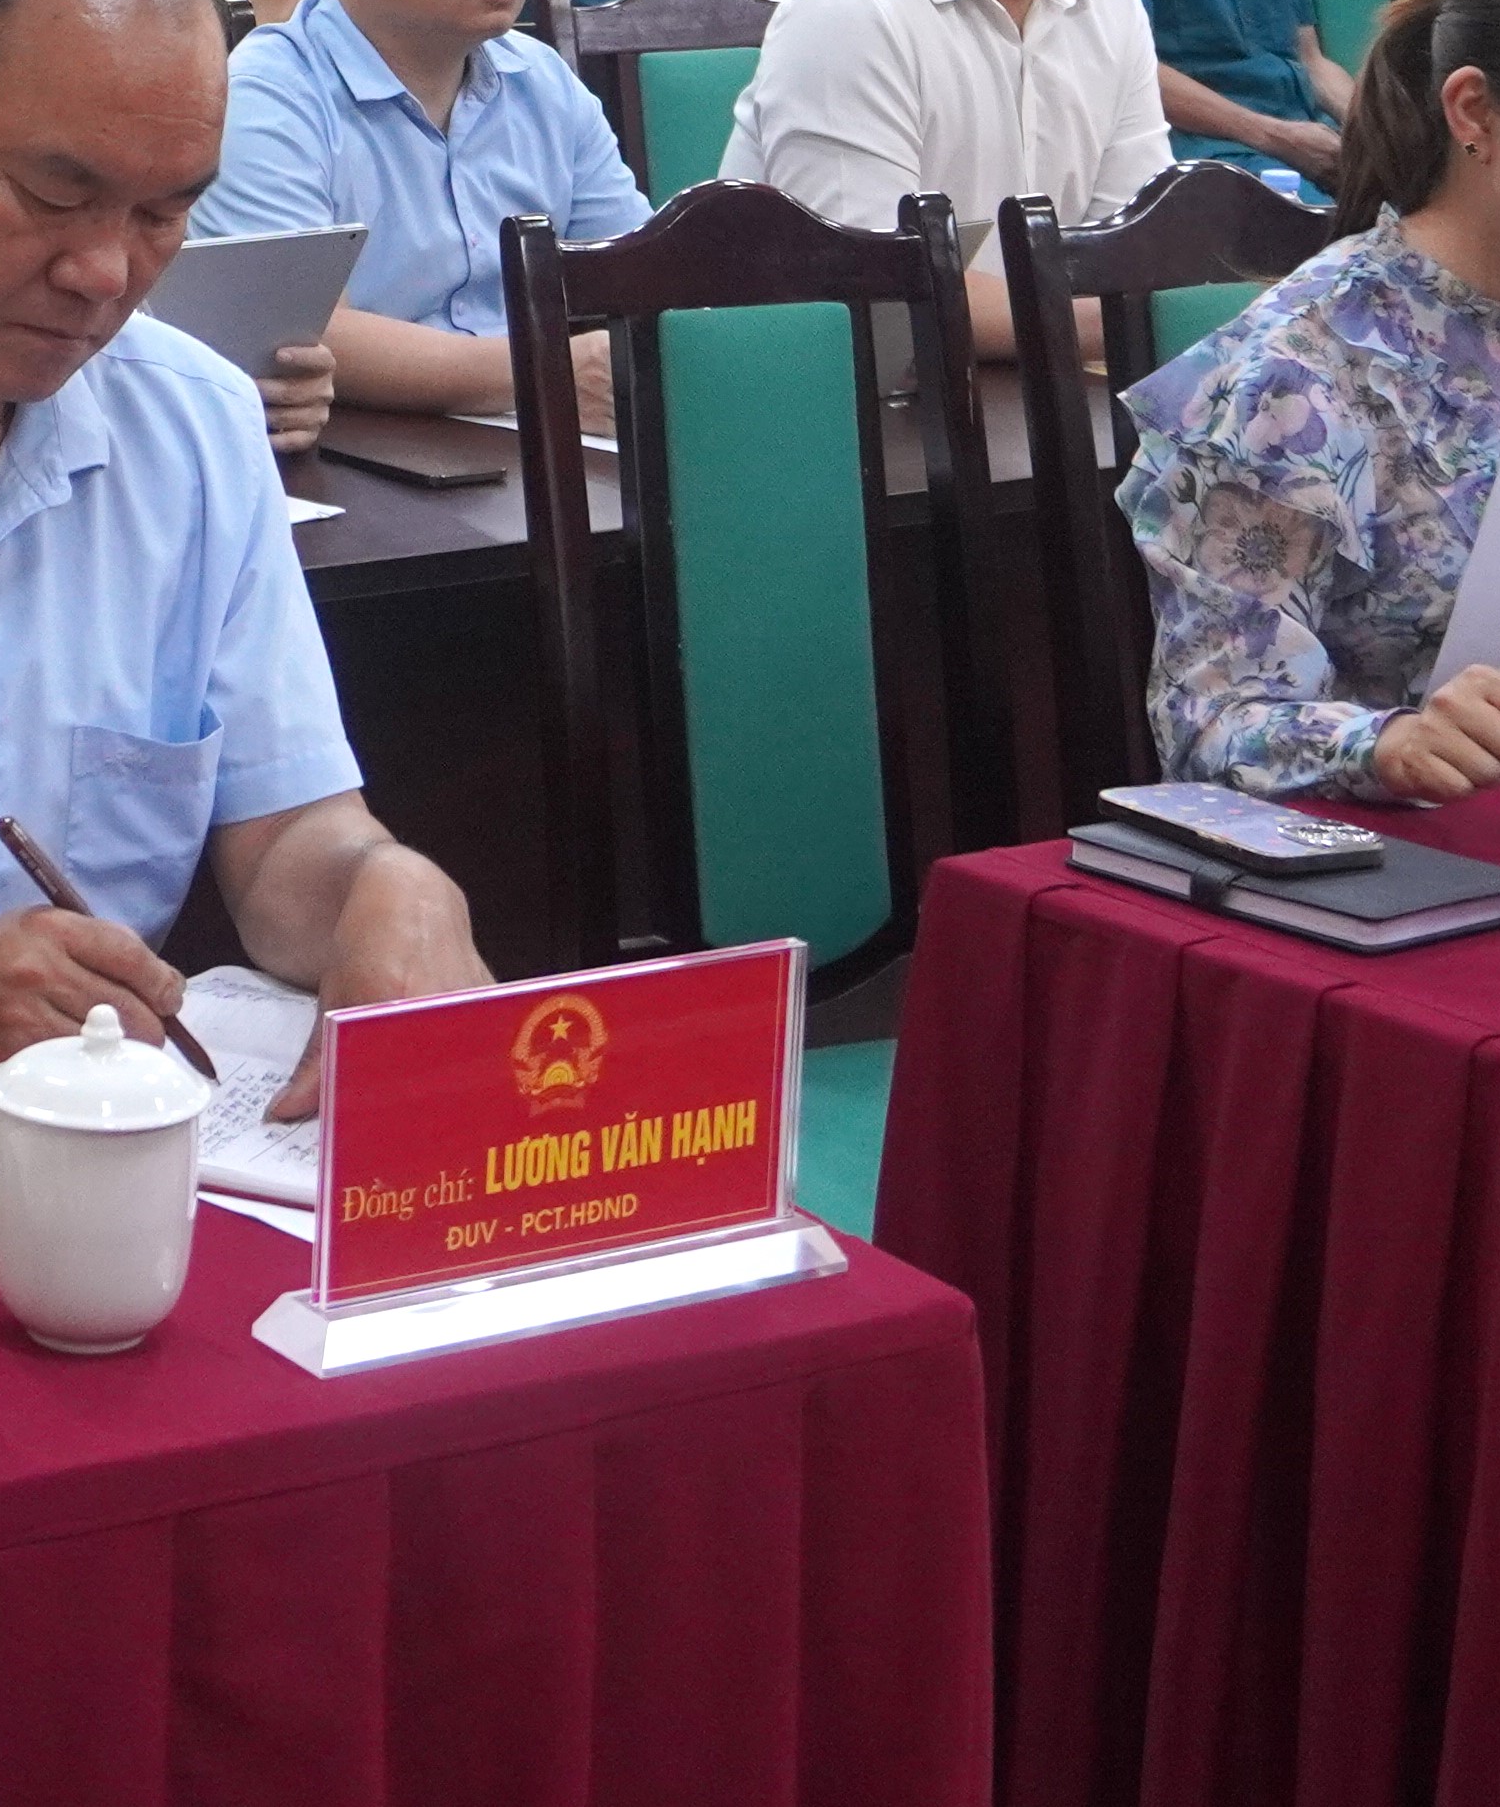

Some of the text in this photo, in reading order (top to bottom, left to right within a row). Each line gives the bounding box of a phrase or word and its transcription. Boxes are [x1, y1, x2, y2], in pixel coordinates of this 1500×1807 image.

[342, 1099, 758, 1225] Đồng chí: LƯƠNG VĂN HẠNH
[445, 1219, 499, 1252] ĐUV
[521, 1193, 638, 1238] PCT.HĐND
